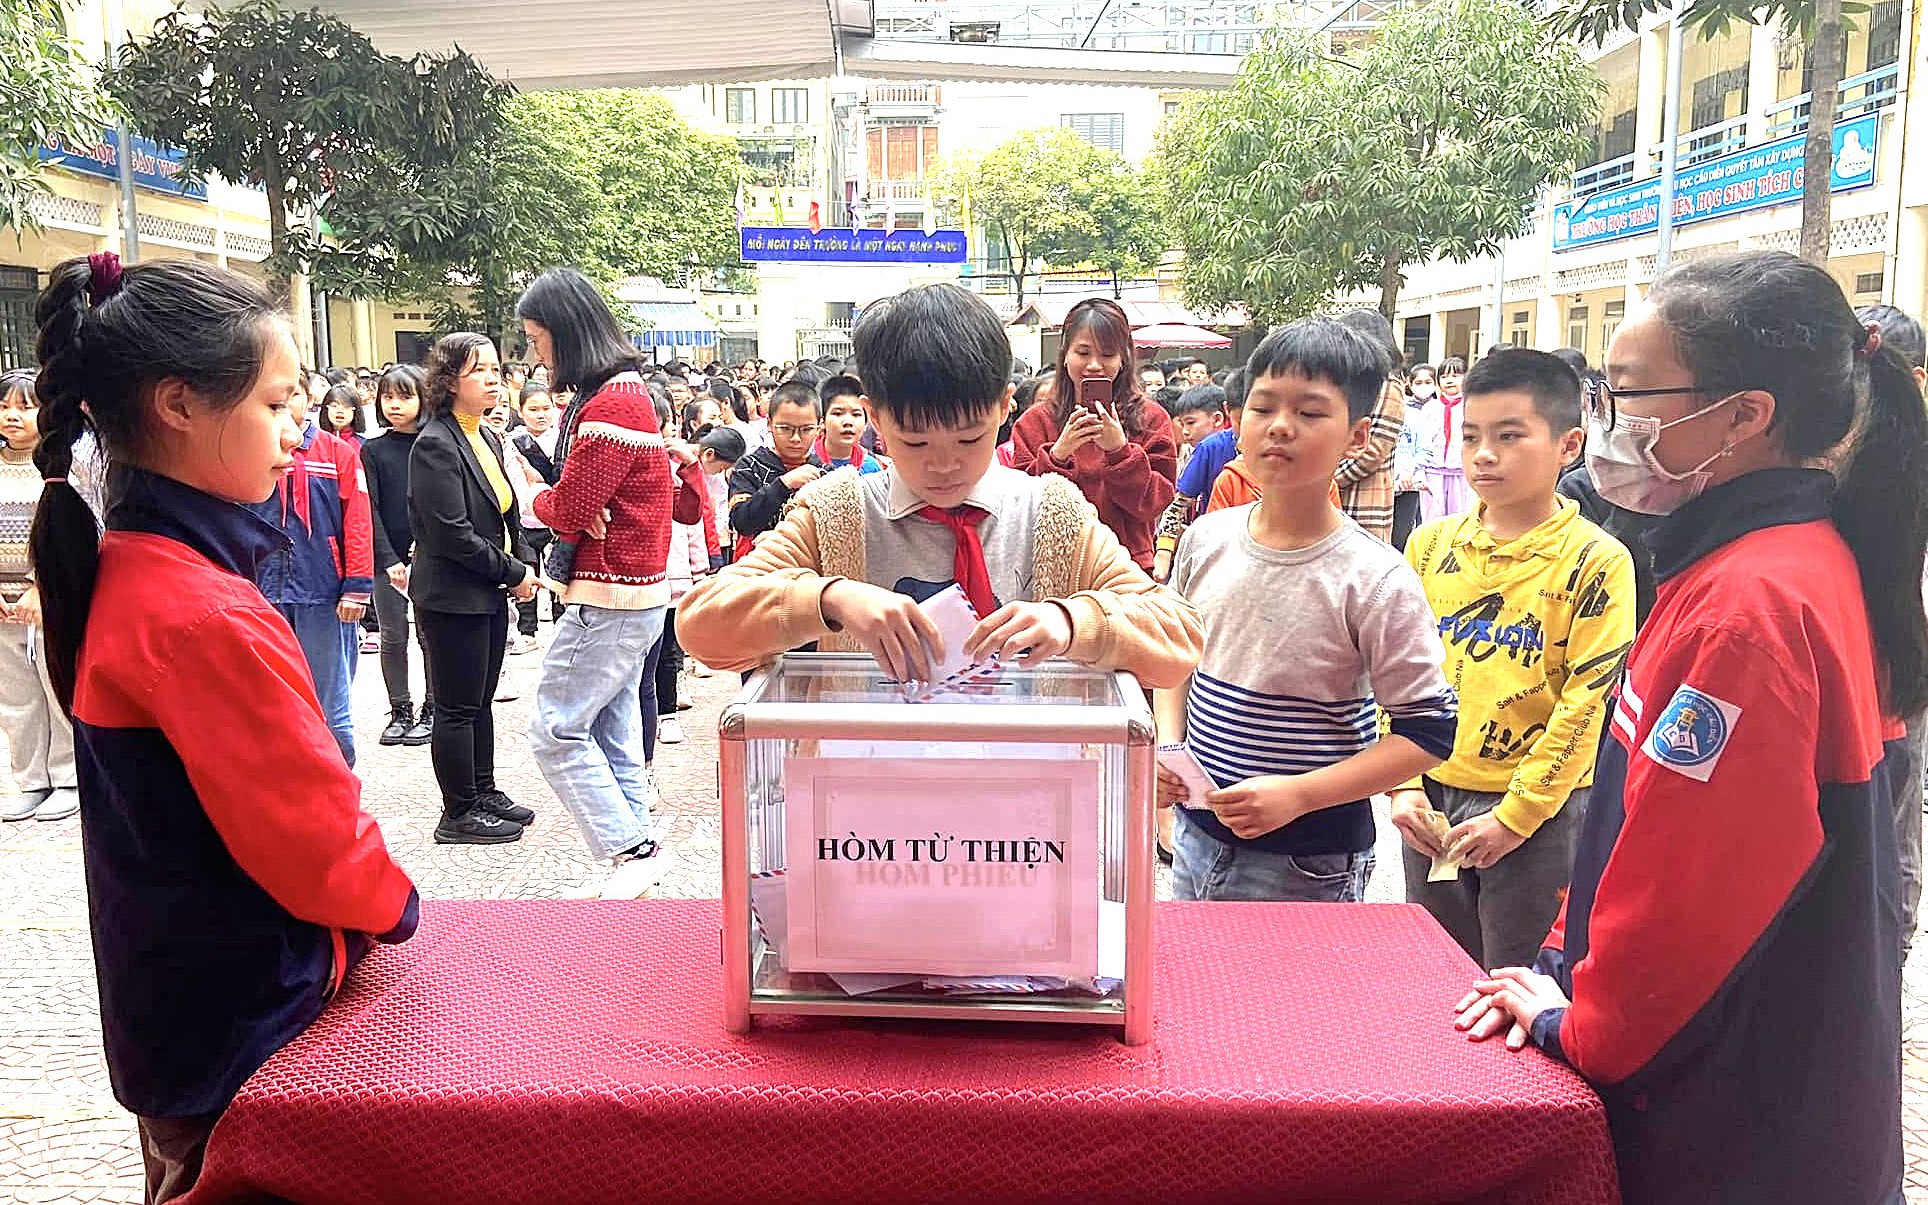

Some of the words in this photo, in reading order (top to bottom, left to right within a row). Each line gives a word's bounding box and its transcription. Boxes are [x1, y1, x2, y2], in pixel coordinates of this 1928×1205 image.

[1696, 188, 1722, 214] HỌC
[1723, 178, 1757, 206] SINH
[1757, 168, 1791, 197] TÍCH
[818, 831, 896, 862] HÒM
[906, 832, 955, 863] TỪ
[961, 837, 1066, 869] THIỆN
